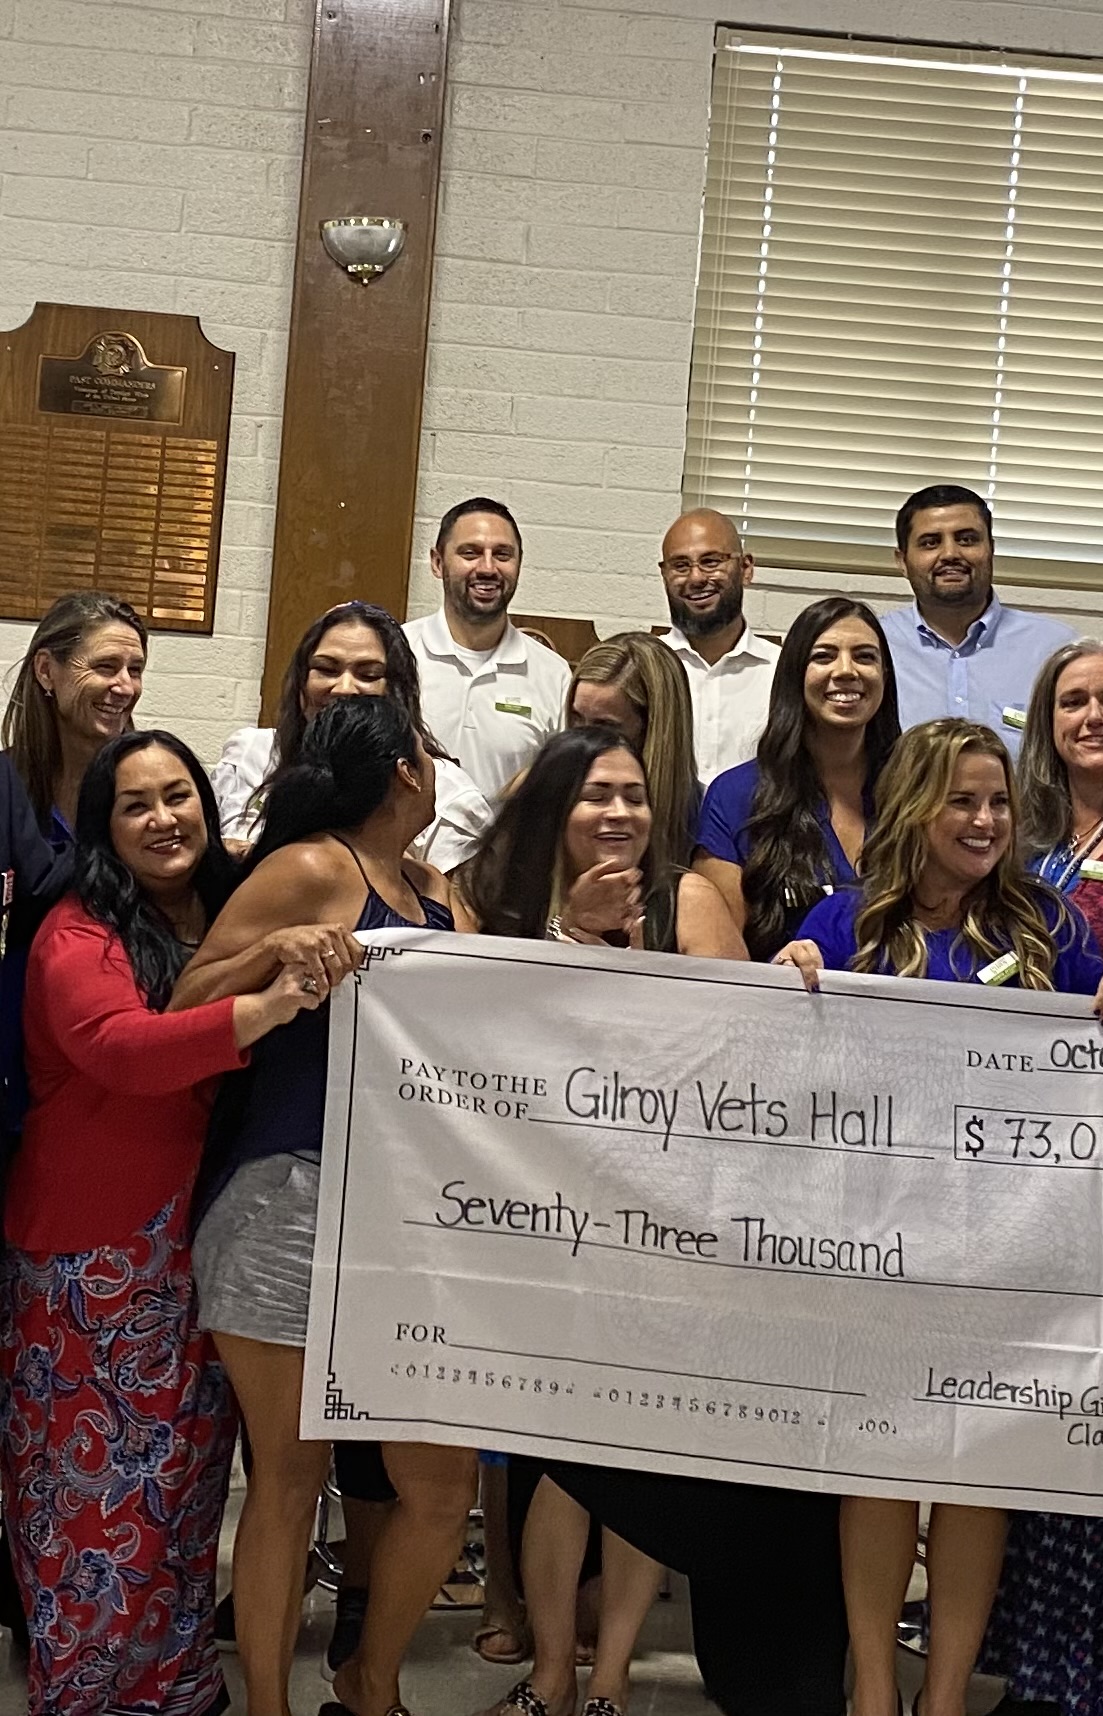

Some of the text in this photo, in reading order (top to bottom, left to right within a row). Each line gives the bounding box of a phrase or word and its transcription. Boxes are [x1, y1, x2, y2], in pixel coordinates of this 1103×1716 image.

[400, 1058, 548, 1097] PAY TO THE
[967, 1050, 1034, 1073] DATE
[399, 1083, 529, 1120] ORDER OF
[565, 1067, 893, 1151] Gilroy Vets Hall
[435, 1180, 905, 1278] Seventy-Three Thousand
[395, 1322, 447, 1344] FOR
[925, 1367, 1072, 1420] Leadership
